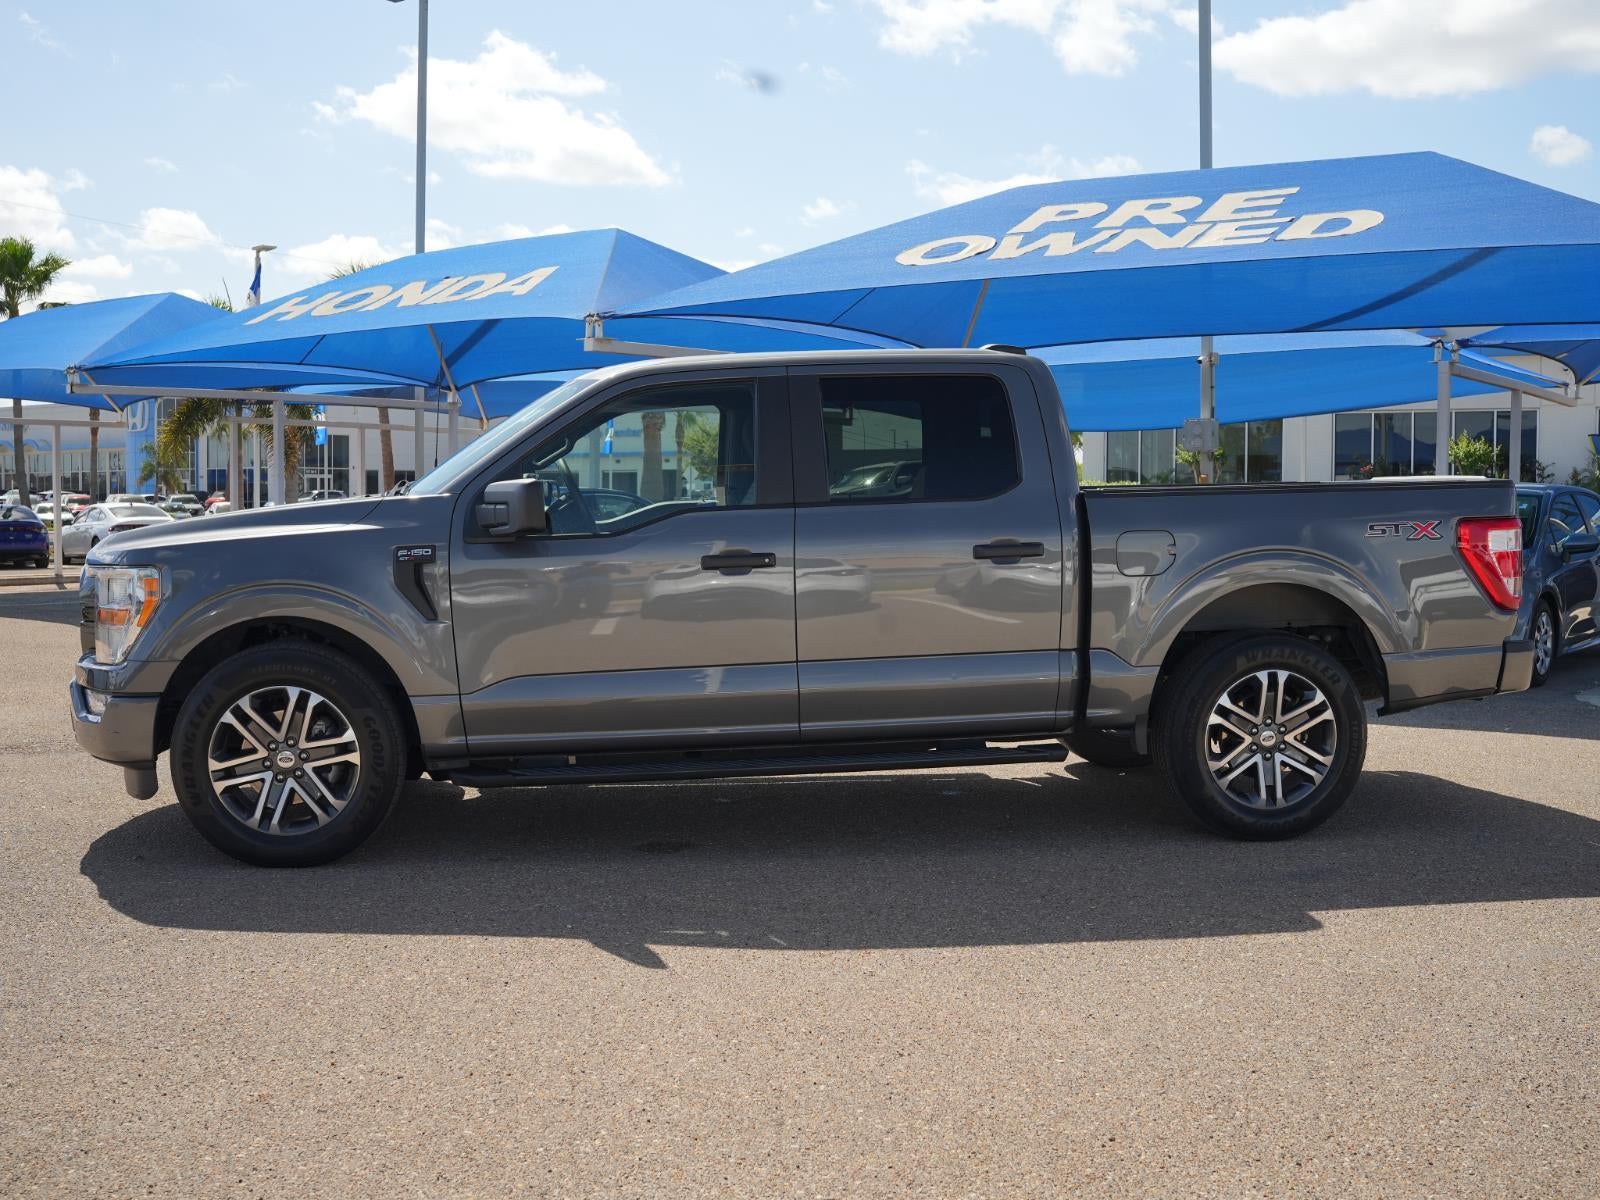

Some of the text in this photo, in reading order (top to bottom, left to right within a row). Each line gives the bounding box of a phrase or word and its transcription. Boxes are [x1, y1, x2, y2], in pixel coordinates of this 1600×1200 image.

[1004, 186, 1301, 234] PRE
[895, 209, 1385, 269] OWNED
[245, 265, 560, 326] HONDA
[1364, 520, 1443, 541] STX
